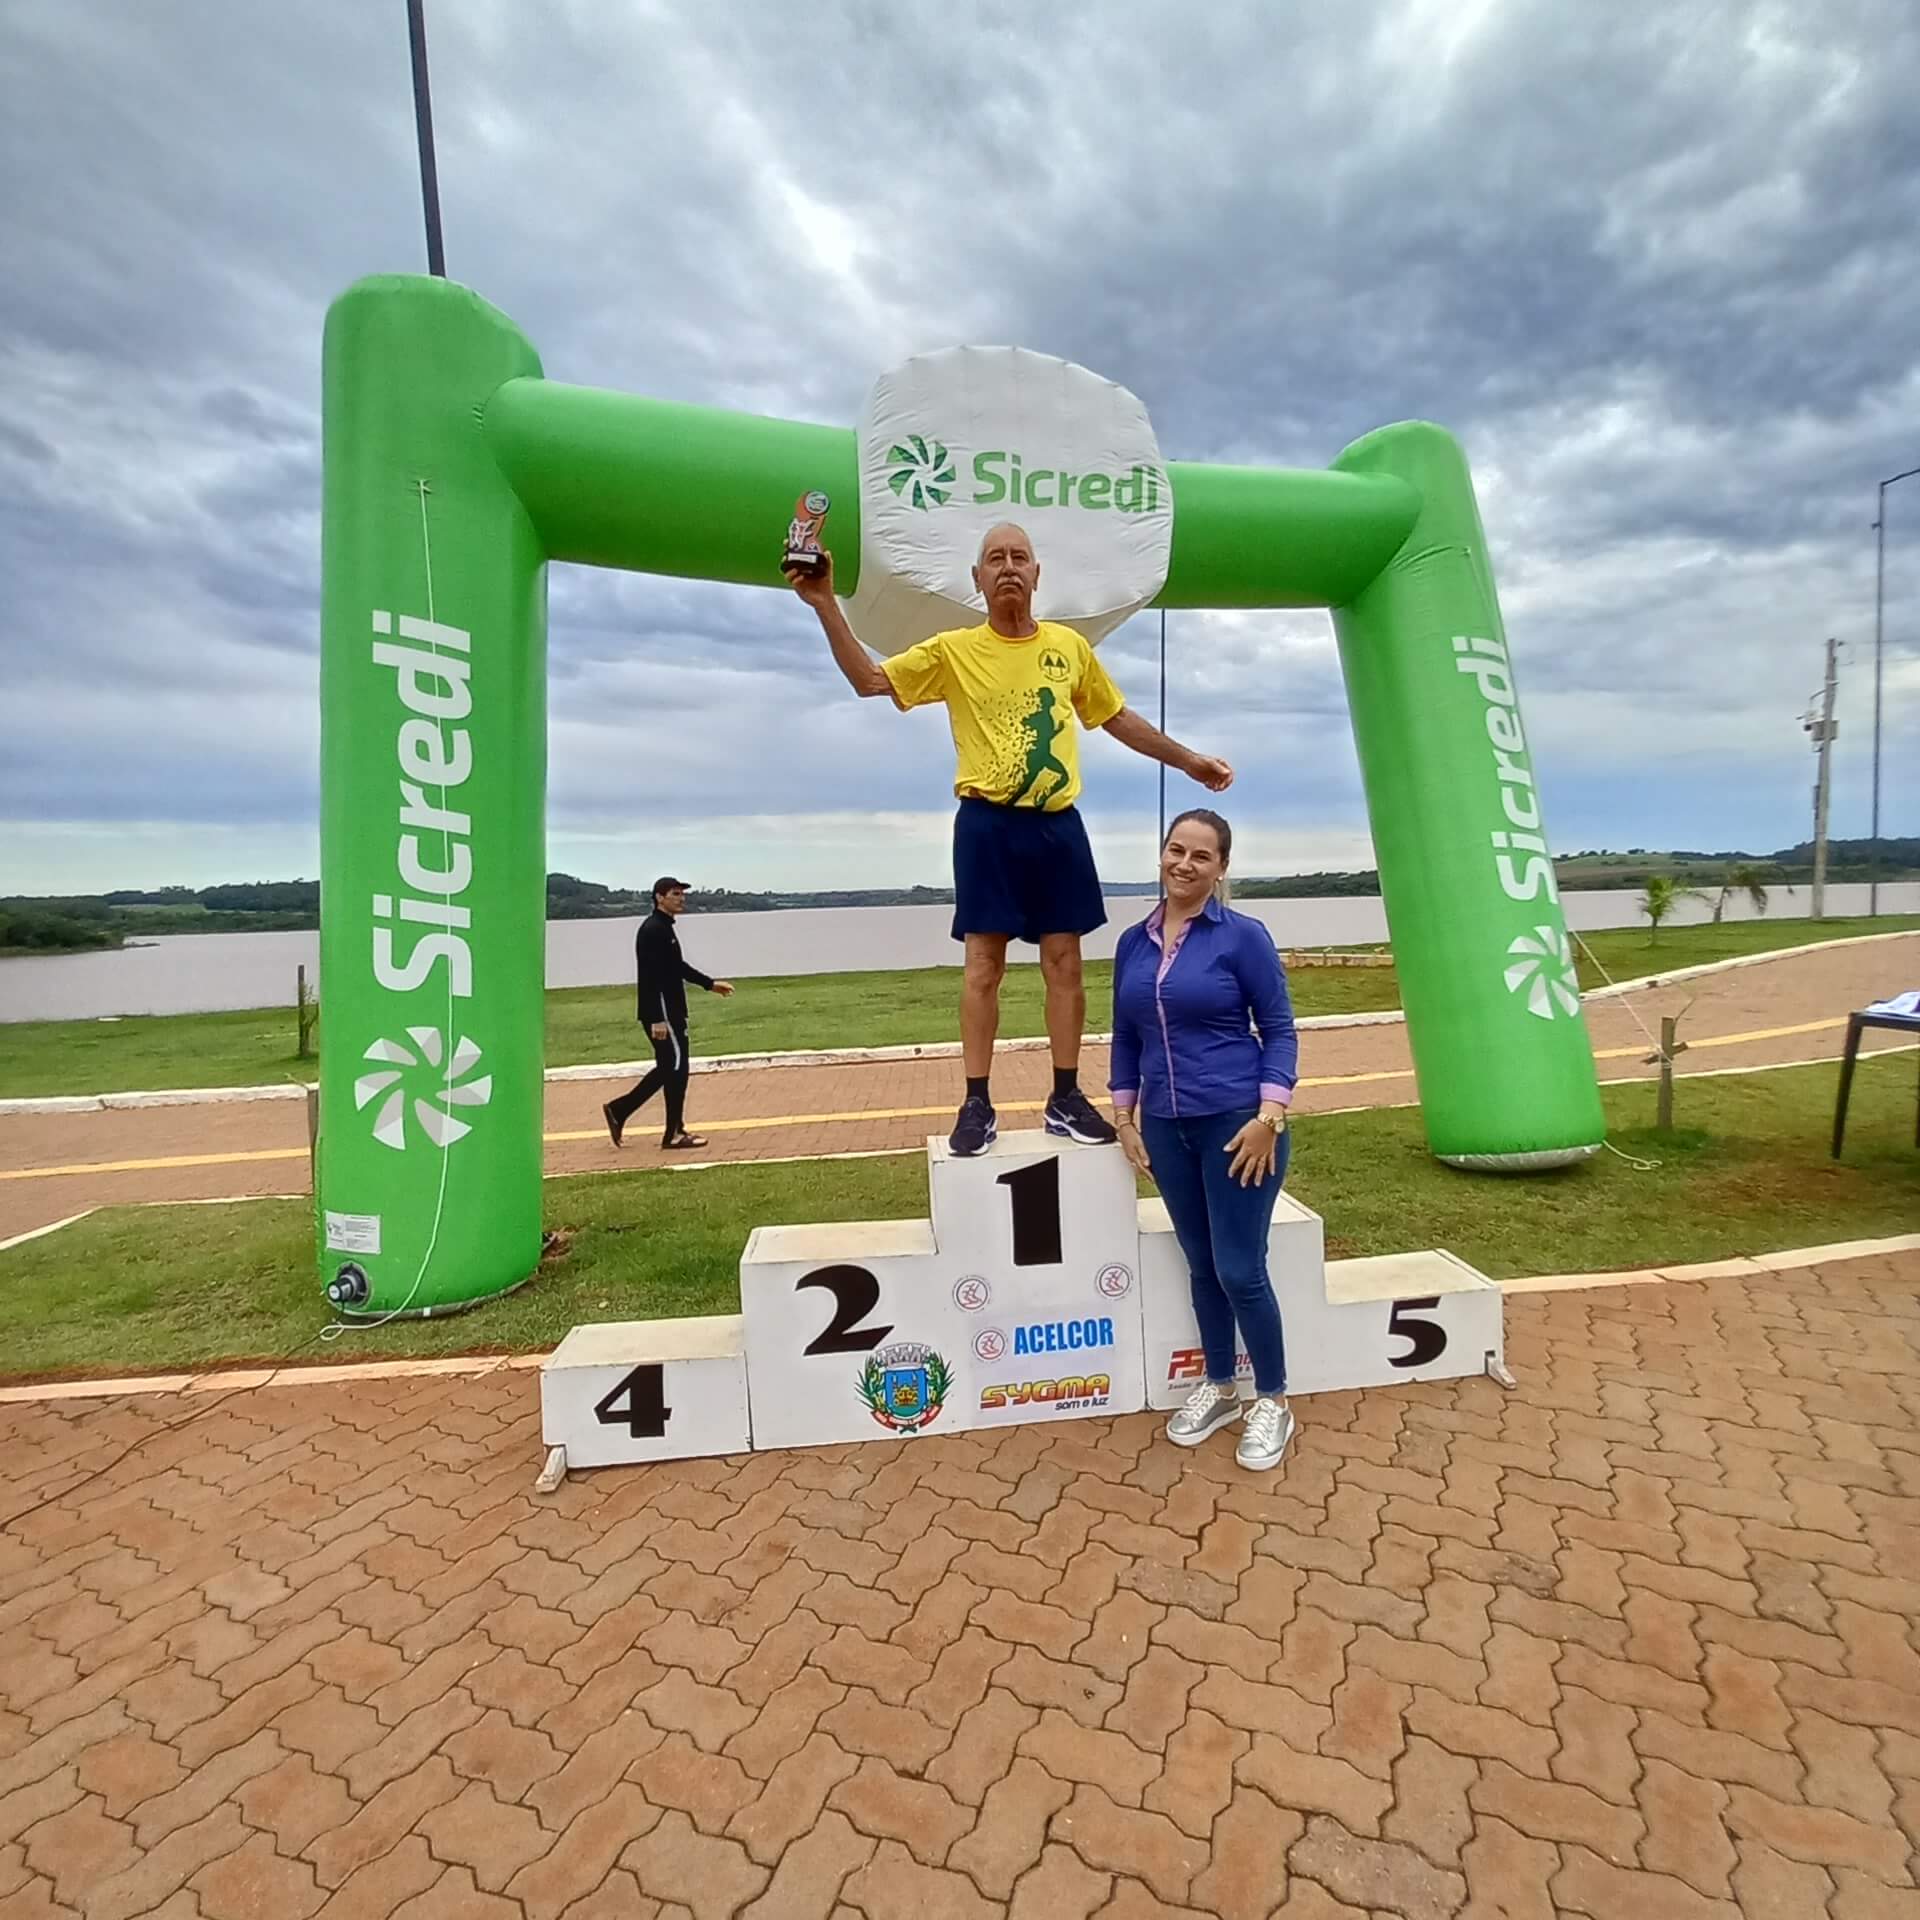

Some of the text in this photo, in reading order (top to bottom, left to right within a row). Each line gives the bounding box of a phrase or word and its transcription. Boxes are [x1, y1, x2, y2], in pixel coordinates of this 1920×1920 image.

[972, 451, 1158, 513] Sicredi
[372, 610, 473, 998] Sicredi
[1452, 636, 1559, 905] Sicredi
[995, 1155, 1063, 1266] 1
[794, 1264, 895, 1357] 2
[1014, 1317, 1114, 1356] ACELCOR
[1386, 1296, 1447, 1369] 5
[593, 1363, 673, 1439] 4
[980, 1373, 1111, 1410] SYGMA
[1055, 1400, 1080, 1411] som
